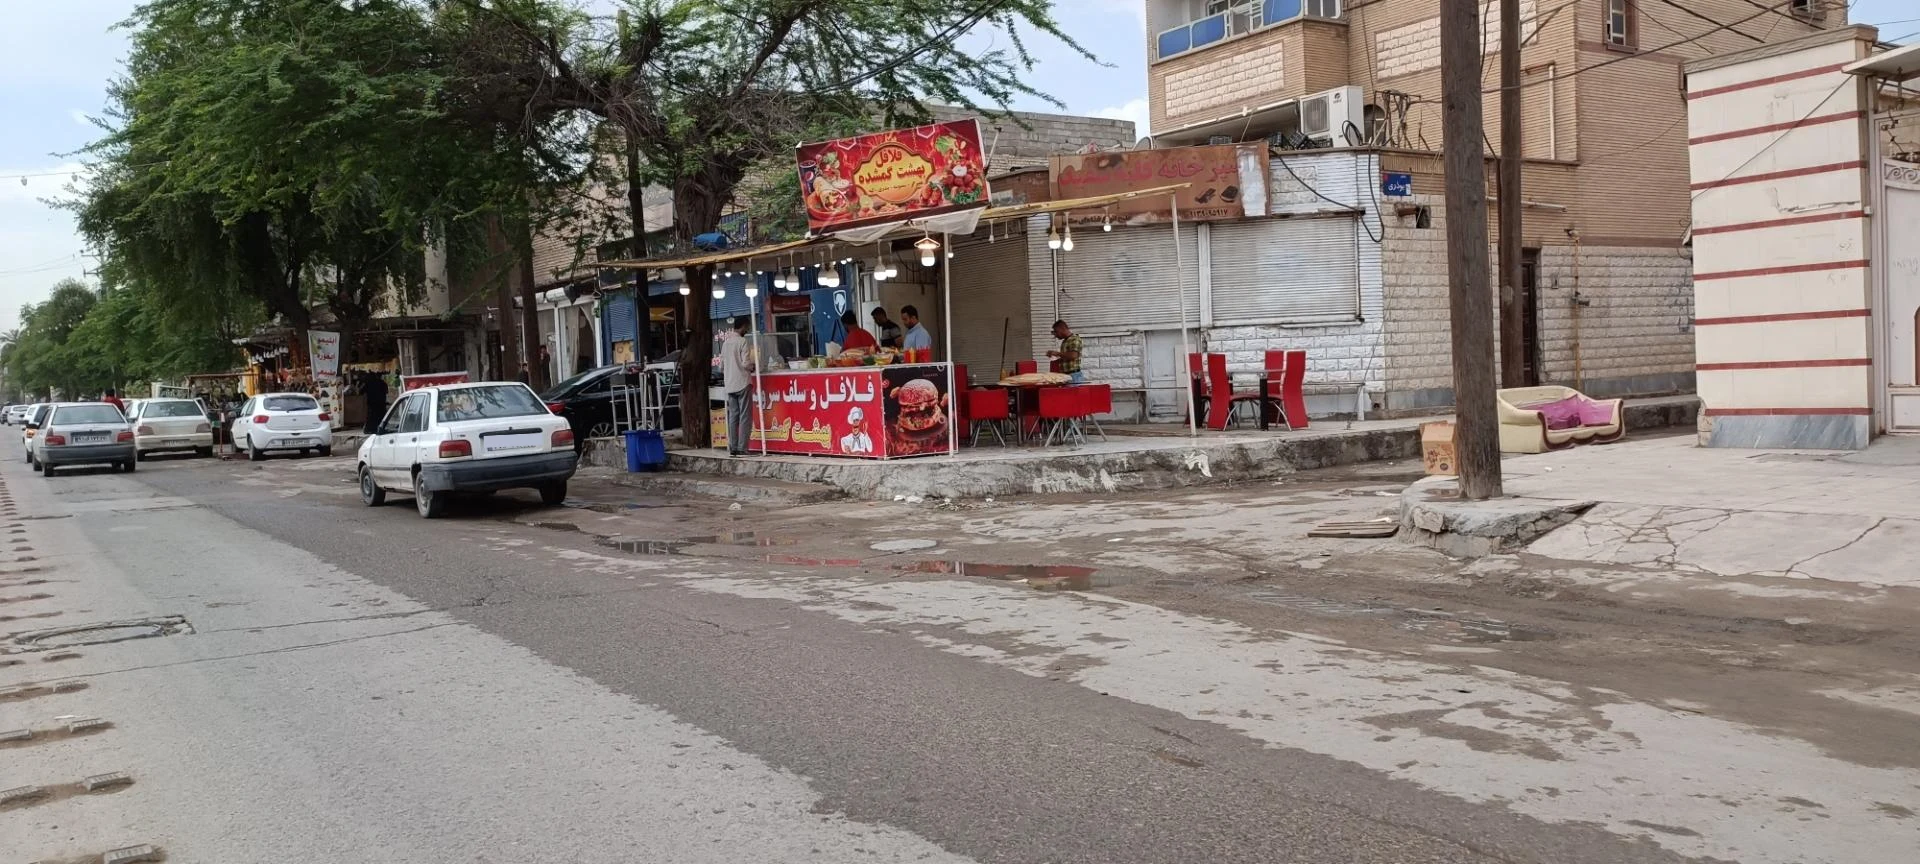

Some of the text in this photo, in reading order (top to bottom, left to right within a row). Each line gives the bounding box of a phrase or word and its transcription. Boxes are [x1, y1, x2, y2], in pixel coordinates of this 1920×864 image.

[876, 148, 902, 168] فلافل
[858, 162, 926, 184] بهشت گمشده
[782, 379, 806, 403] سلف
[808, 389, 817, 410] و
[820, 375, 875, 410] فلافل
[792, 416, 833, 450] بهشت
